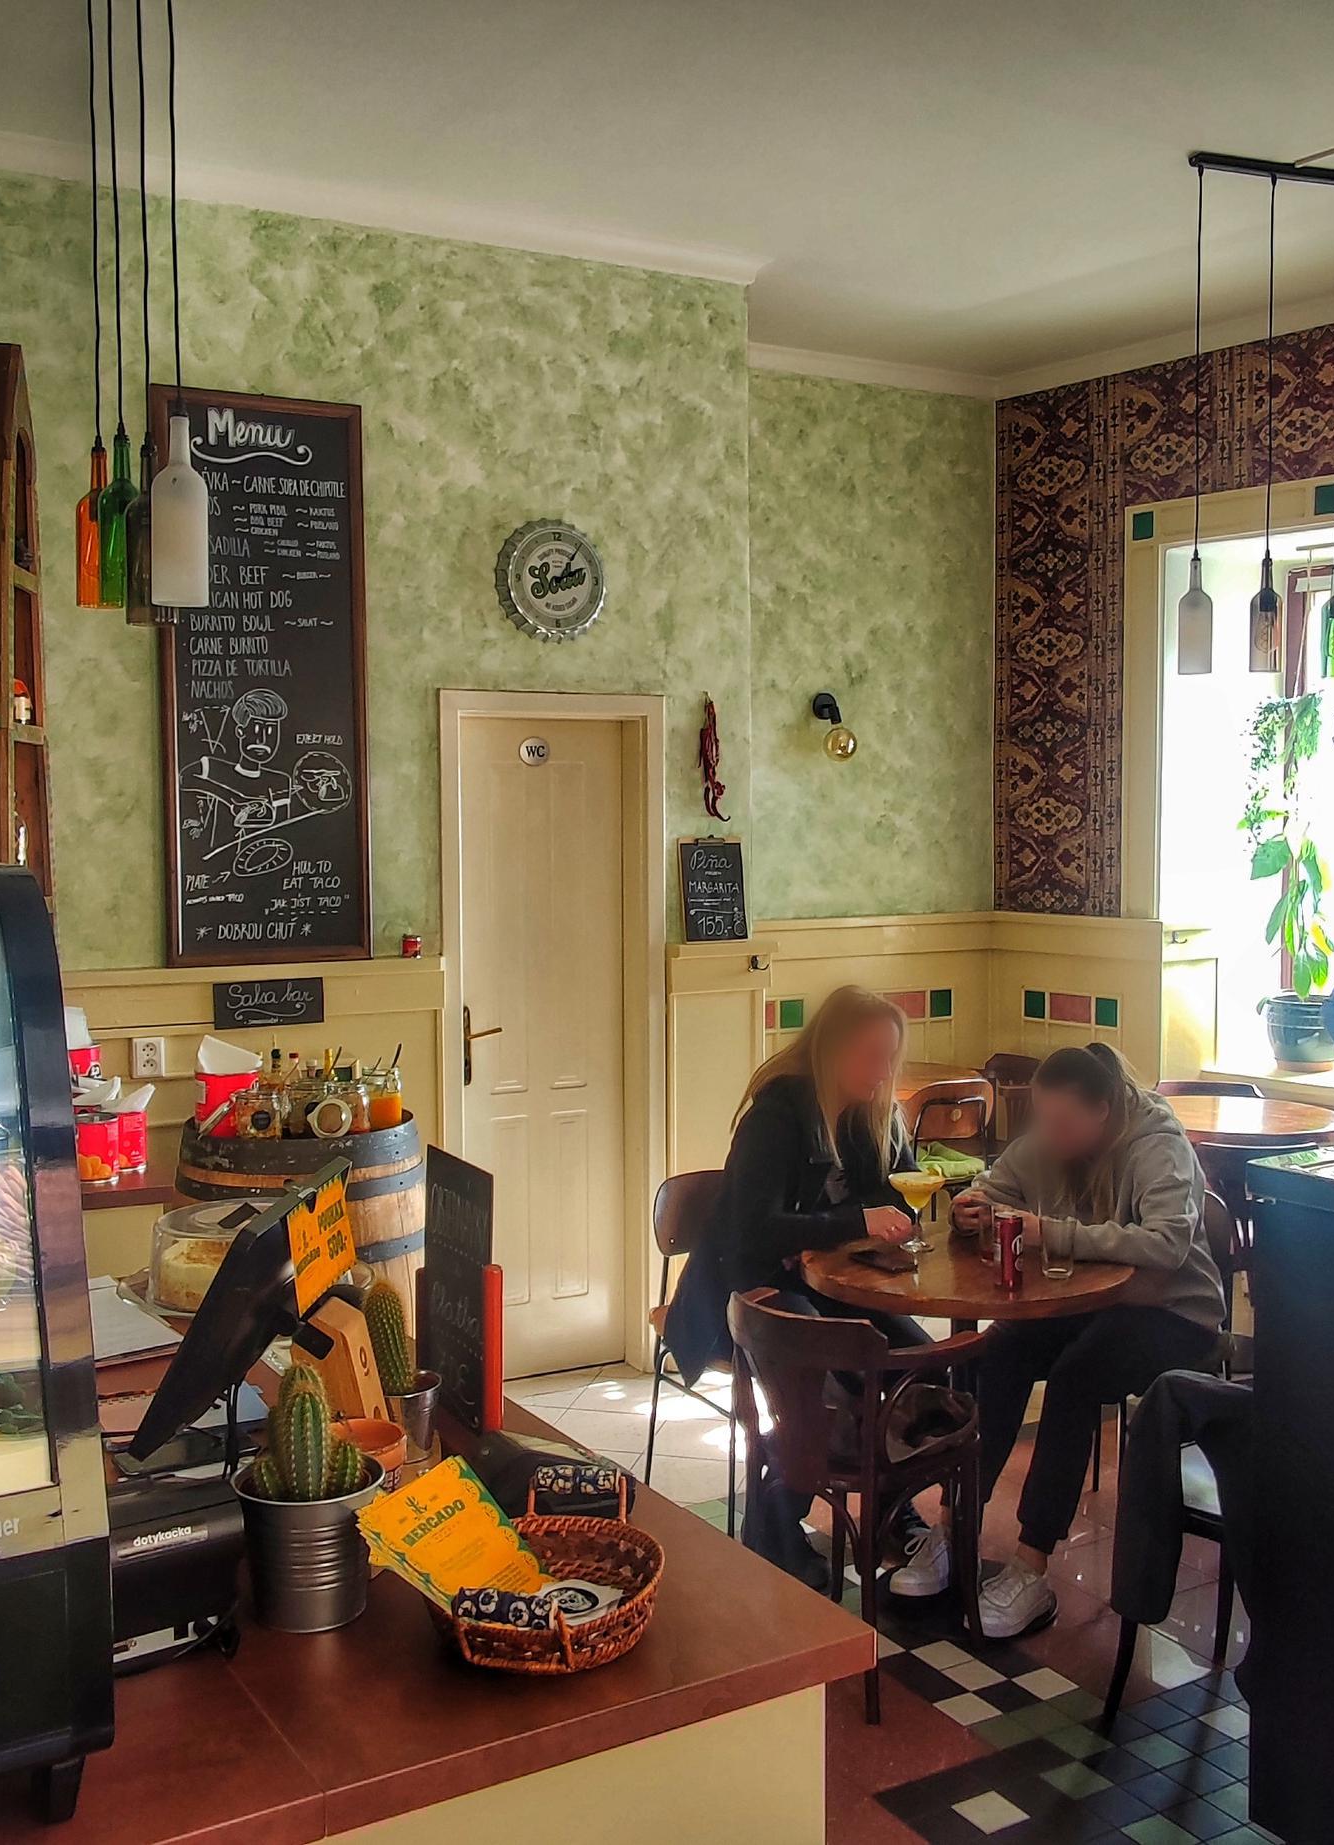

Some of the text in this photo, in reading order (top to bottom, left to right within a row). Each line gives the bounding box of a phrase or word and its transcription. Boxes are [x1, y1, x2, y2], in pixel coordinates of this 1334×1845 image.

[207, 407, 296, 448] Menu
[201, 466, 229, 492] ÉVKA
[243, 475, 276, 495] CARNE
[299, 479, 310, 497] DE
[209, 535, 251, 558] SADILLA
[239, 565, 270, 585] BEEF
[242, 590, 264, 609] HOT
[270, 590, 293, 608] DOG
[189, 613, 275, 632] BURRITO BOWL
[189, 635, 268, 656] CARNE BURRITO
[191, 658, 292, 677] PIZZA DE TORTILLA
[190, 680, 235, 699] NACHOS
[525, 745, 545, 758] WC
[317, 860, 332, 873] TO
[689, 849, 733, 871] Piña
[185, 874, 211, 892] PLATE
[282, 876, 341, 890] EAT TACO
[688, 880, 740, 894] MARGARITA
[218, 923, 263, 940] DOBROU
[227, 981, 314, 1009] Salsa bar
[402, 1498, 466, 1547] MERCADO
